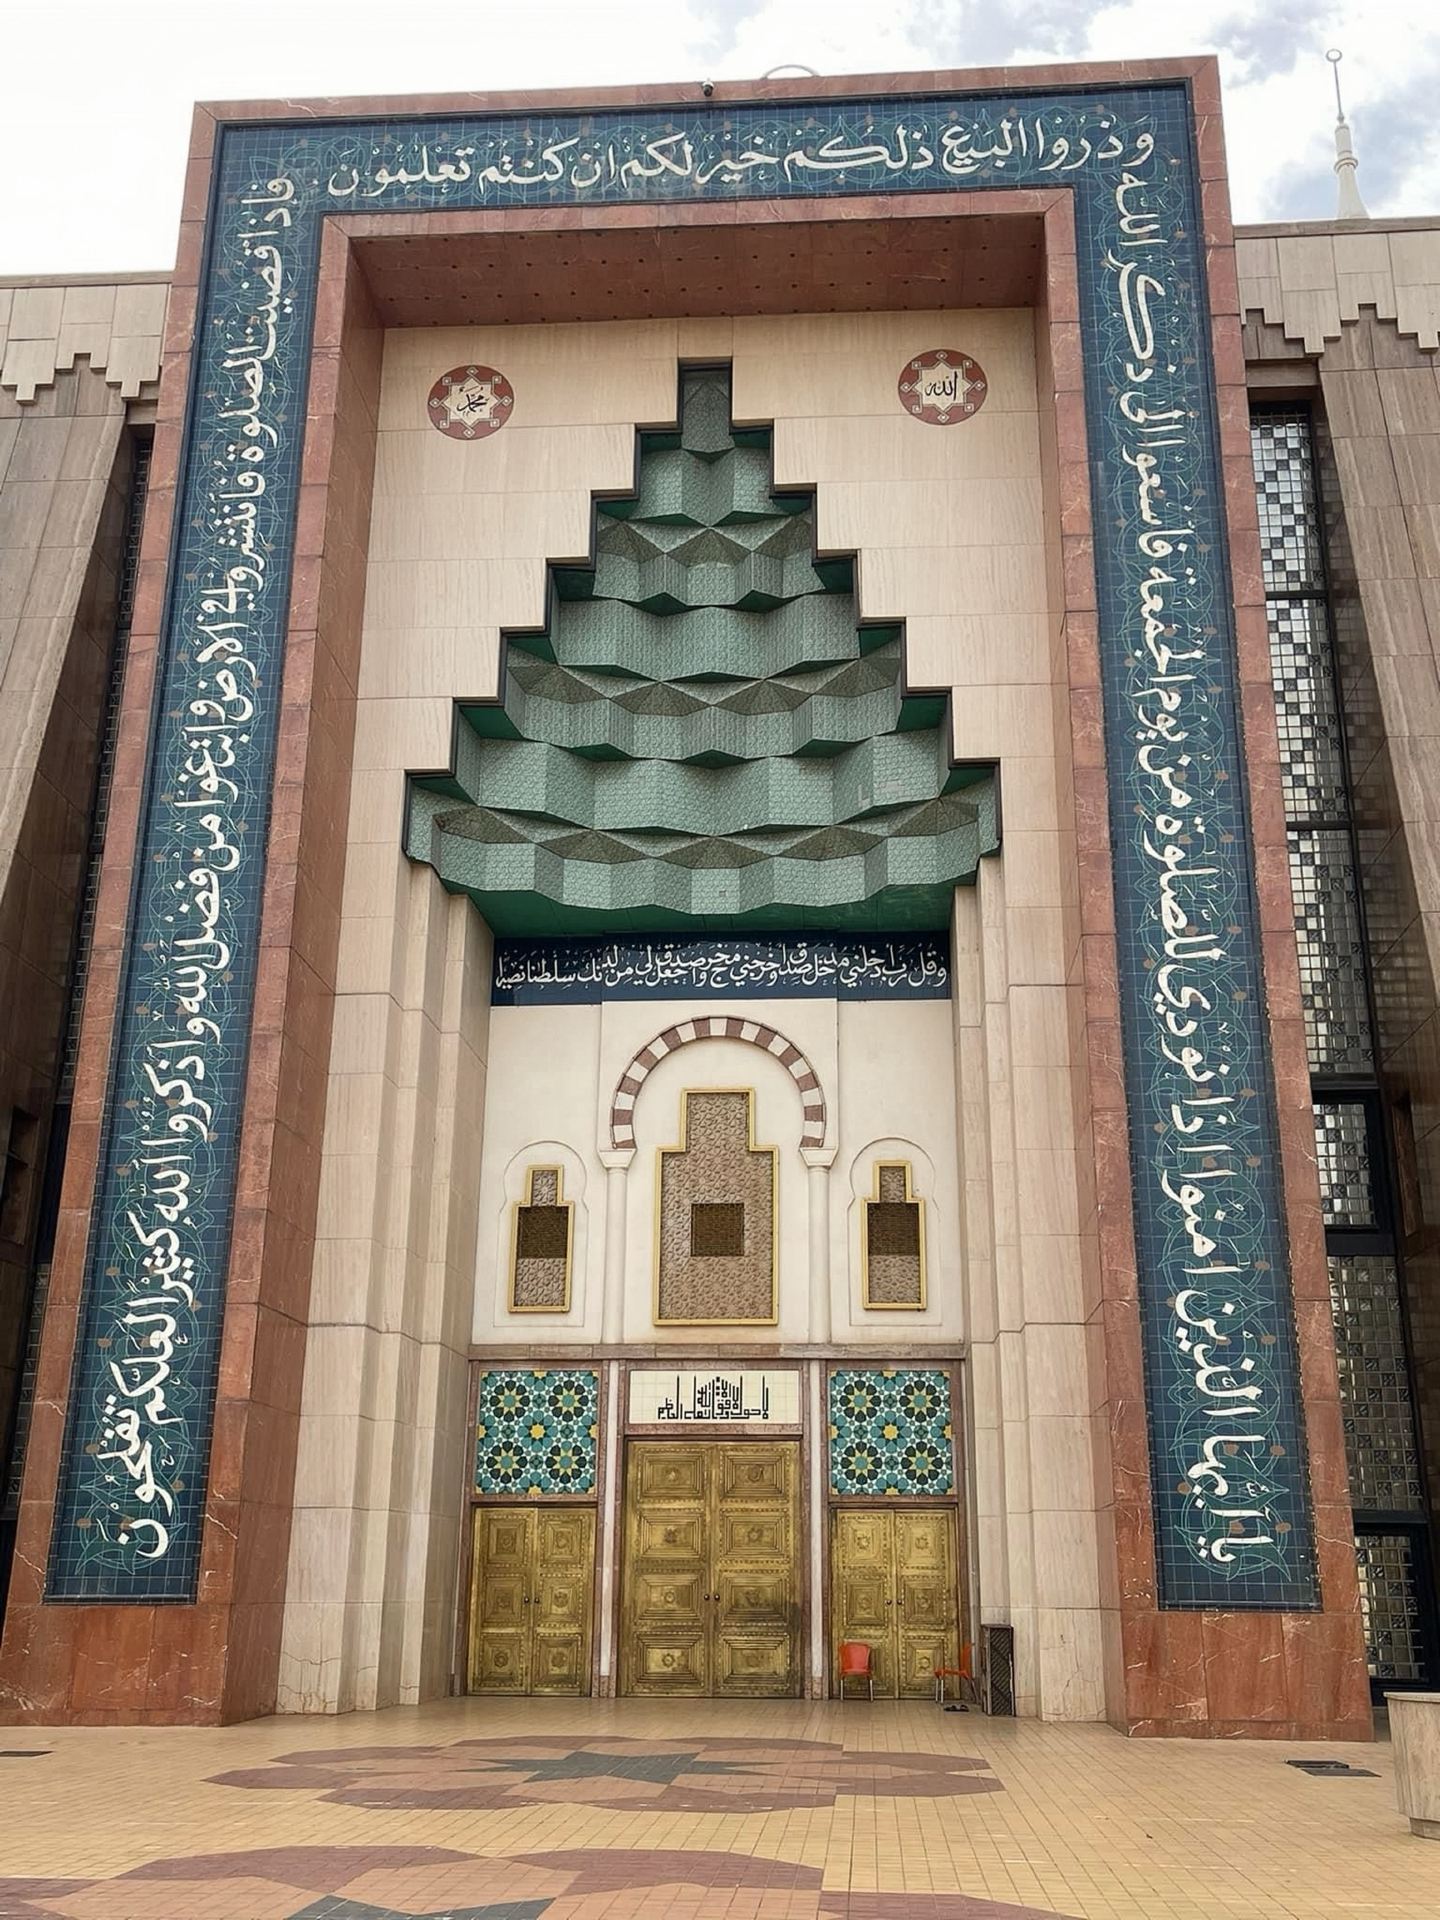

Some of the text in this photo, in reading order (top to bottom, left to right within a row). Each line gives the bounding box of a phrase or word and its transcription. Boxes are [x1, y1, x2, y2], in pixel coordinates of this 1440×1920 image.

[328, 142, 476, 198] تعلمون
[478, 138, 580, 194] كنتم
[620, 131, 694, 189] لكم
[697, 133, 780, 186] خير
[783, 122, 936, 184] ذلكم
[941, 118, 1029, 176] البيع
[1114, 172, 1169, 244] الله
[240, 246, 293, 360] قضيت
[1107, 249, 1178, 383] ذكر
[457, 392, 489, 413] محمد
[925, 371, 958, 402] الله
[1121, 438, 1196, 558] فاسعوا
[200, 472, 266, 595] فانتشروا
[199, 574, 256, 615] في
[1135, 567, 1207, 682] الجمعة
[1131, 687, 1189, 742] يوم
[174, 700, 248, 808] وابتغوا
[1138, 745, 1193, 807] من
[190, 813, 241, 871] من
[174, 868, 226, 969] فضل
[165, 955, 219, 1013] الله
[605, 962, 634, 987] من
[908, 948, 947, 987] وقل
[1153, 964, 1231, 1082] نودي
[143, 1018, 221, 1145] واذكروا
[134, 1155, 194, 1222] الله
[110, 1313, 184, 1424] لعلكم
[1176, 1290, 1263, 1416] الذين
[97, 1395, 173, 1557] تفلحون
